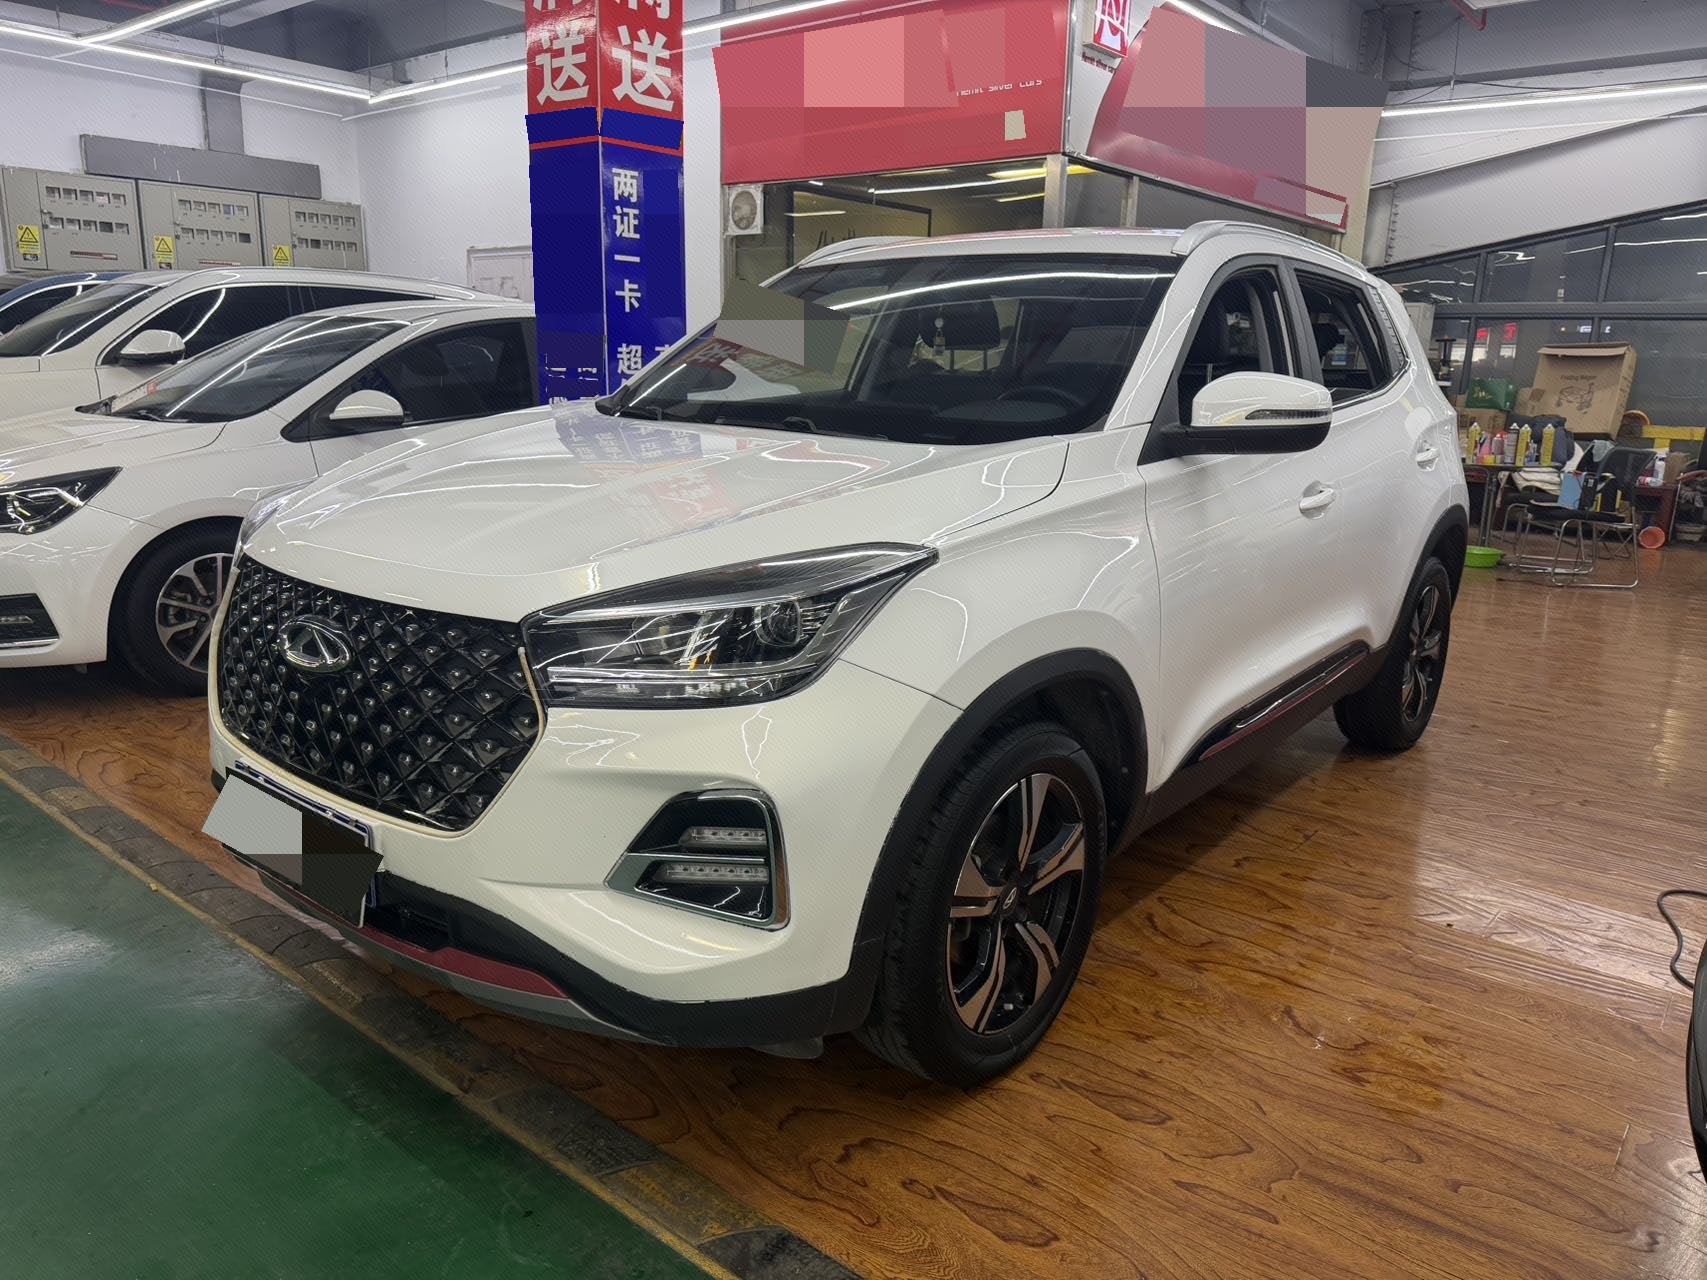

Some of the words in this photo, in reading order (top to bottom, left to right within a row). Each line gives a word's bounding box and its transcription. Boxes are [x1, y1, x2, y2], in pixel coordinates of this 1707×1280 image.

[531, 0, 590, 106] 送
[611, 0, 674, 112] 送
[611, 166, 642, 313] 两证一卡
